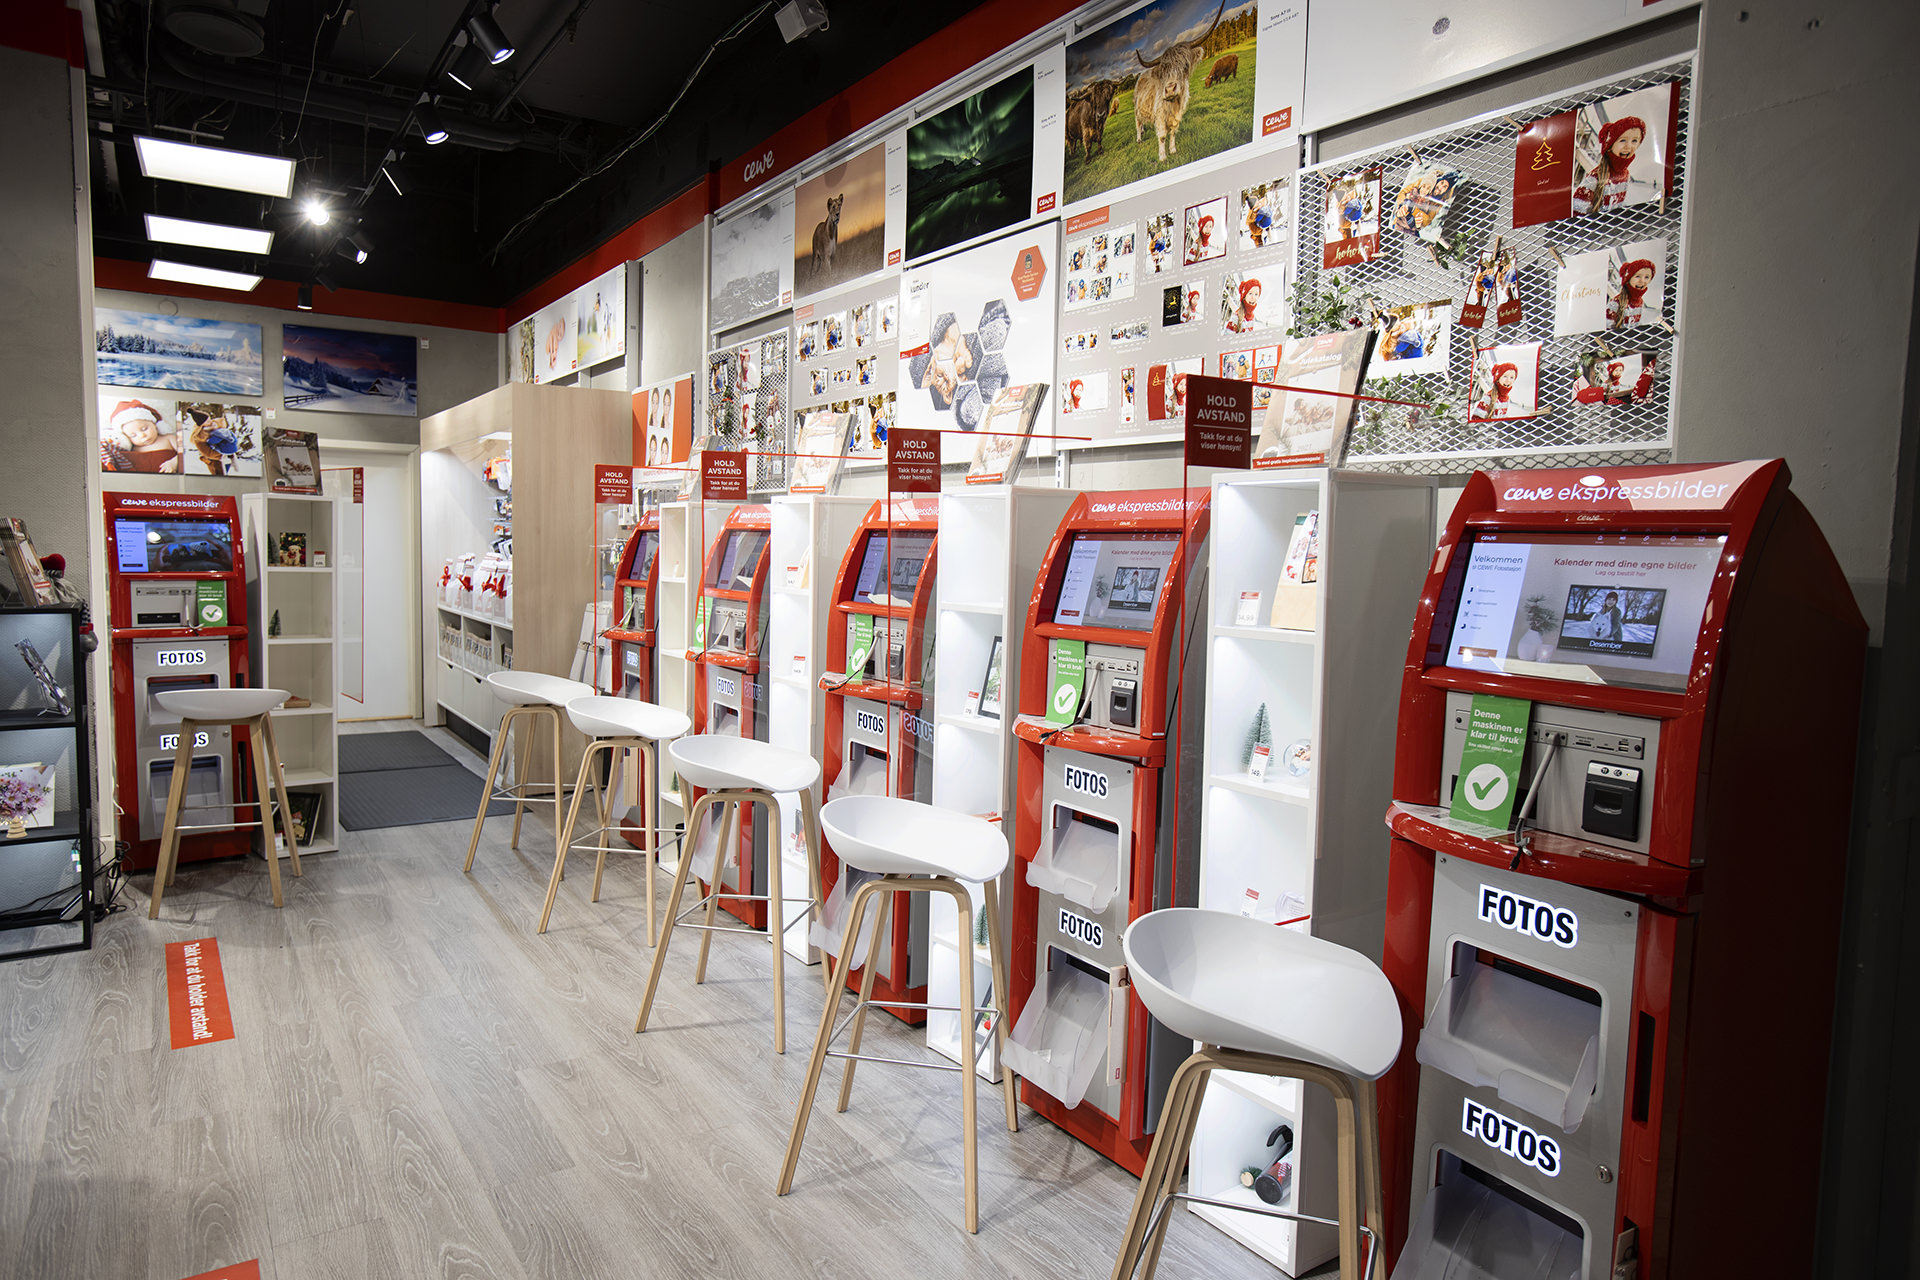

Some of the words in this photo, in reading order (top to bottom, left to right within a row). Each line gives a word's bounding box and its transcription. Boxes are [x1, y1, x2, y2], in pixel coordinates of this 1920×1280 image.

[1265, 112, 1289, 127] cewe
[743, 150, 775, 183] cewe
[1207, 394, 1237, 408] HOLD
[1196, 408, 1246, 423] AVSTAND
[1199, 432, 1215, 440] Takk
[903, 440, 928, 449] HOLD
[1217, 443, 1242, 452] hensyn!
[895, 450, 935, 460] AVSTAND
[605, 471, 624, 479] HOLD
[707, 467, 742, 476] AVSTAND
[599, 477, 629, 485] AVSTAND
[1503, 486, 1554, 502] cewe
[1557, 480, 1729, 504] ekspressbilder
[122, 498, 148, 506] cewe
[148, 498, 220, 509] ekspressbilder
[1091, 501, 1117, 513] cewe
[1116, 498, 1195, 514] ekspressbilder
[1474, 555, 1524, 564] Velkommen
[1553, 558, 1593, 568] Kalender
[1594, 559, 1616, 568] med
[1617, 560, 1639, 569] dine
[1640, 561, 1665, 571] egne
[1667, 561, 1697, 571] bilder
[1588, 639, 1623, 650] Desember
[159, 651, 205, 665] FOTOS
[716, 677, 735, 696] FOTOS
[1474, 709, 1501, 720] Denne
[857, 711, 884, 735] FOTOS
[1472, 721, 1512, 732] maskinen
[161, 733, 208, 749] FOS
[1470, 730, 1487, 739] klar
[1488, 733, 1498, 741] til
[1499, 734, 1520, 745] bruk
[1065, 765, 1108, 798] FOTOS
[1480, 886, 1576, 947] FOTOS
[1060, 909, 1103, 948] FOTOS
[184, 944, 201, 957] Takk
[185, 957, 202, 966] for
[186, 967, 203, 975] at
[187, 975, 205, 984] du
[188, 983, 207, 1006] holder
[191, 1007, 213, 1040] avstand!
[1464, 1099, 1559, 1175] FOTOS
